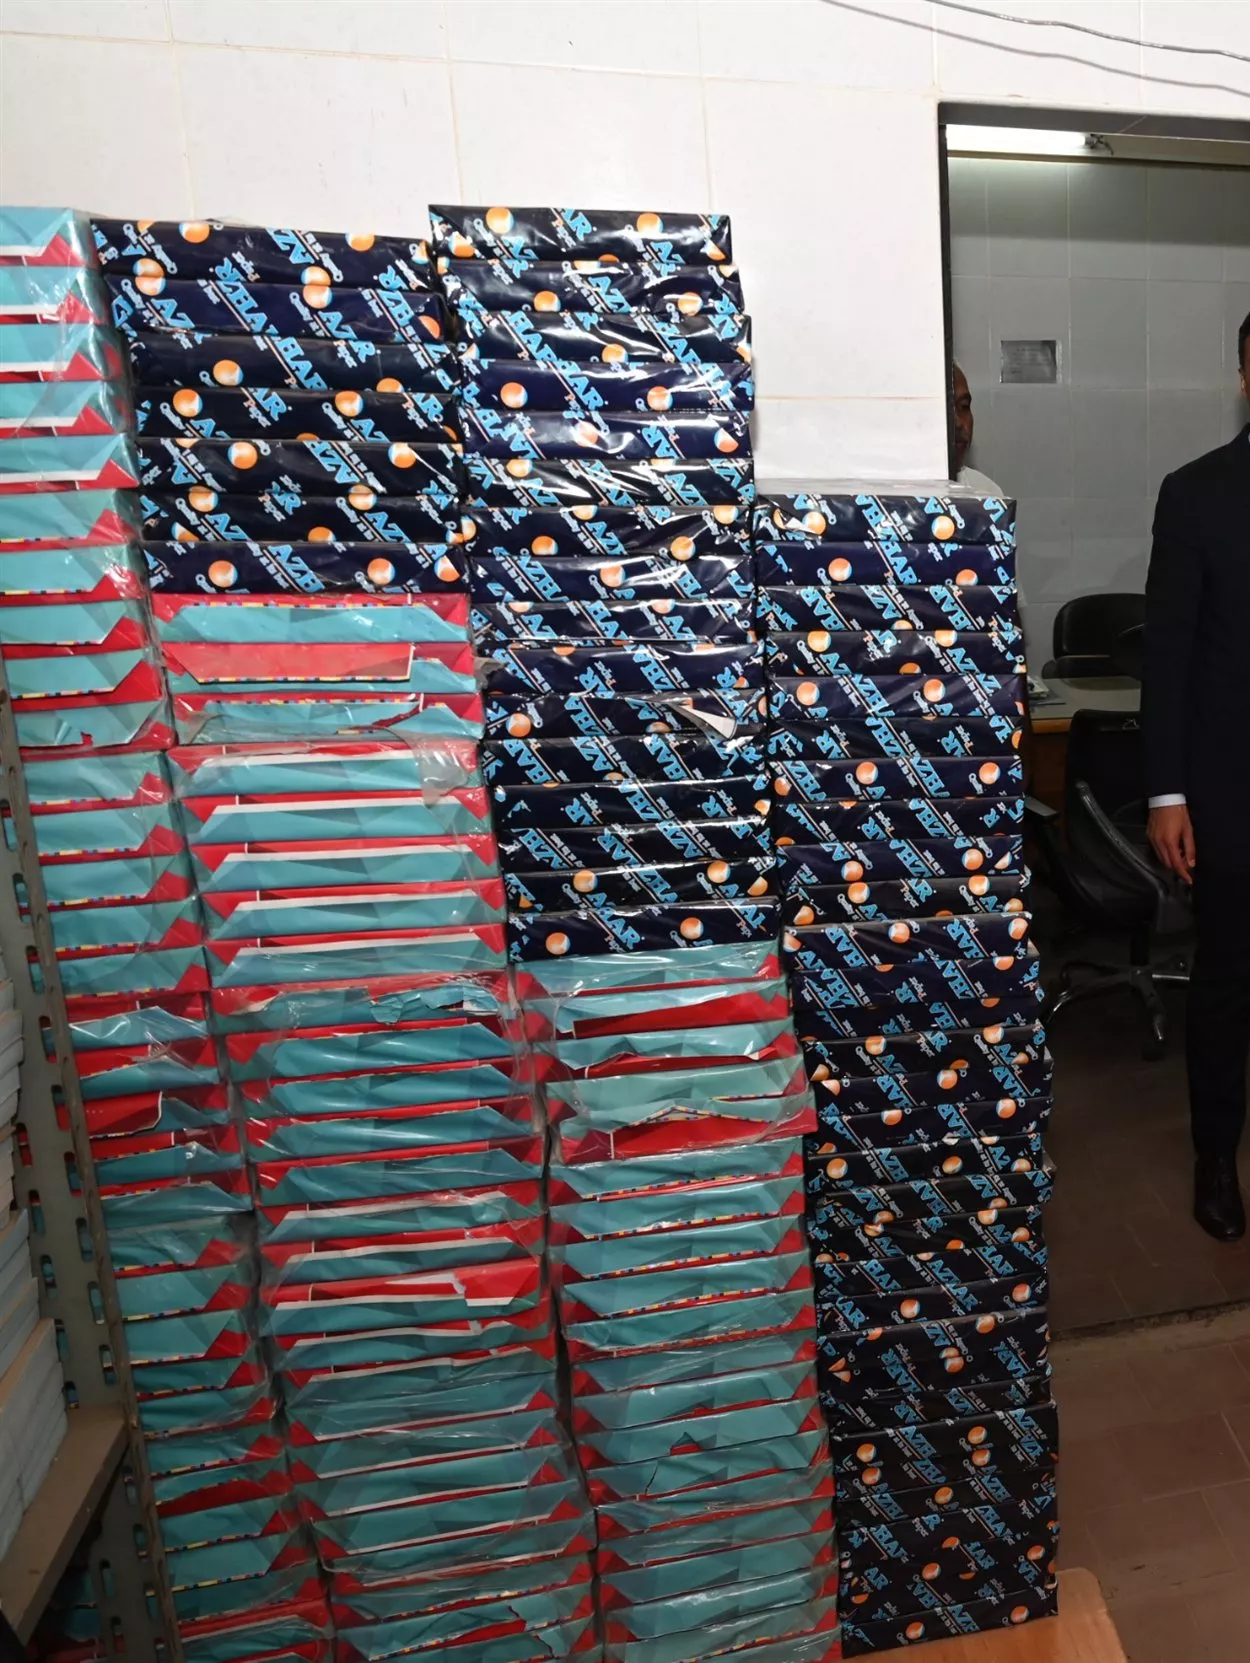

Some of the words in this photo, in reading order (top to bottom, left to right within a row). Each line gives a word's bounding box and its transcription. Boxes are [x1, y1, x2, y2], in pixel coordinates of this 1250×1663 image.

[231, 251, 261, 282] Paper
[243, 399, 272, 428] Paper
[402, 400, 428, 430] Paper
[257, 493, 286, 523] Paper
[267, 544, 326, 593] AZH
[879, 541, 918, 586] HAR
[800, 586, 846, 631] HAR
[594, 660, 617, 685] Paper
[829, 724, 850, 748] Paper
[955, 724, 975, 750] Paper
[503, 739, 552, 784] HAR
[783, 761, 827, 801] ZHA
[580, 792, 602, 818] Paper
[717, 789, 737, 817] Paper
[875, 810, 895, 834] Paper
[909, 799, 951, 838] ZHA
[518, 828, 568, 870] AZH
[899, 879, 920, 908] Paper
[825, 927, 866, 967] HAR
[908, 976, 928, 1000] Paper
[916, 1036, 935, 1057] Paper
[876, 1148, 909, 1183] AZH
[865, 1259, 901, 1291] HAR
[912, 1517, 930, 1537] Paper
